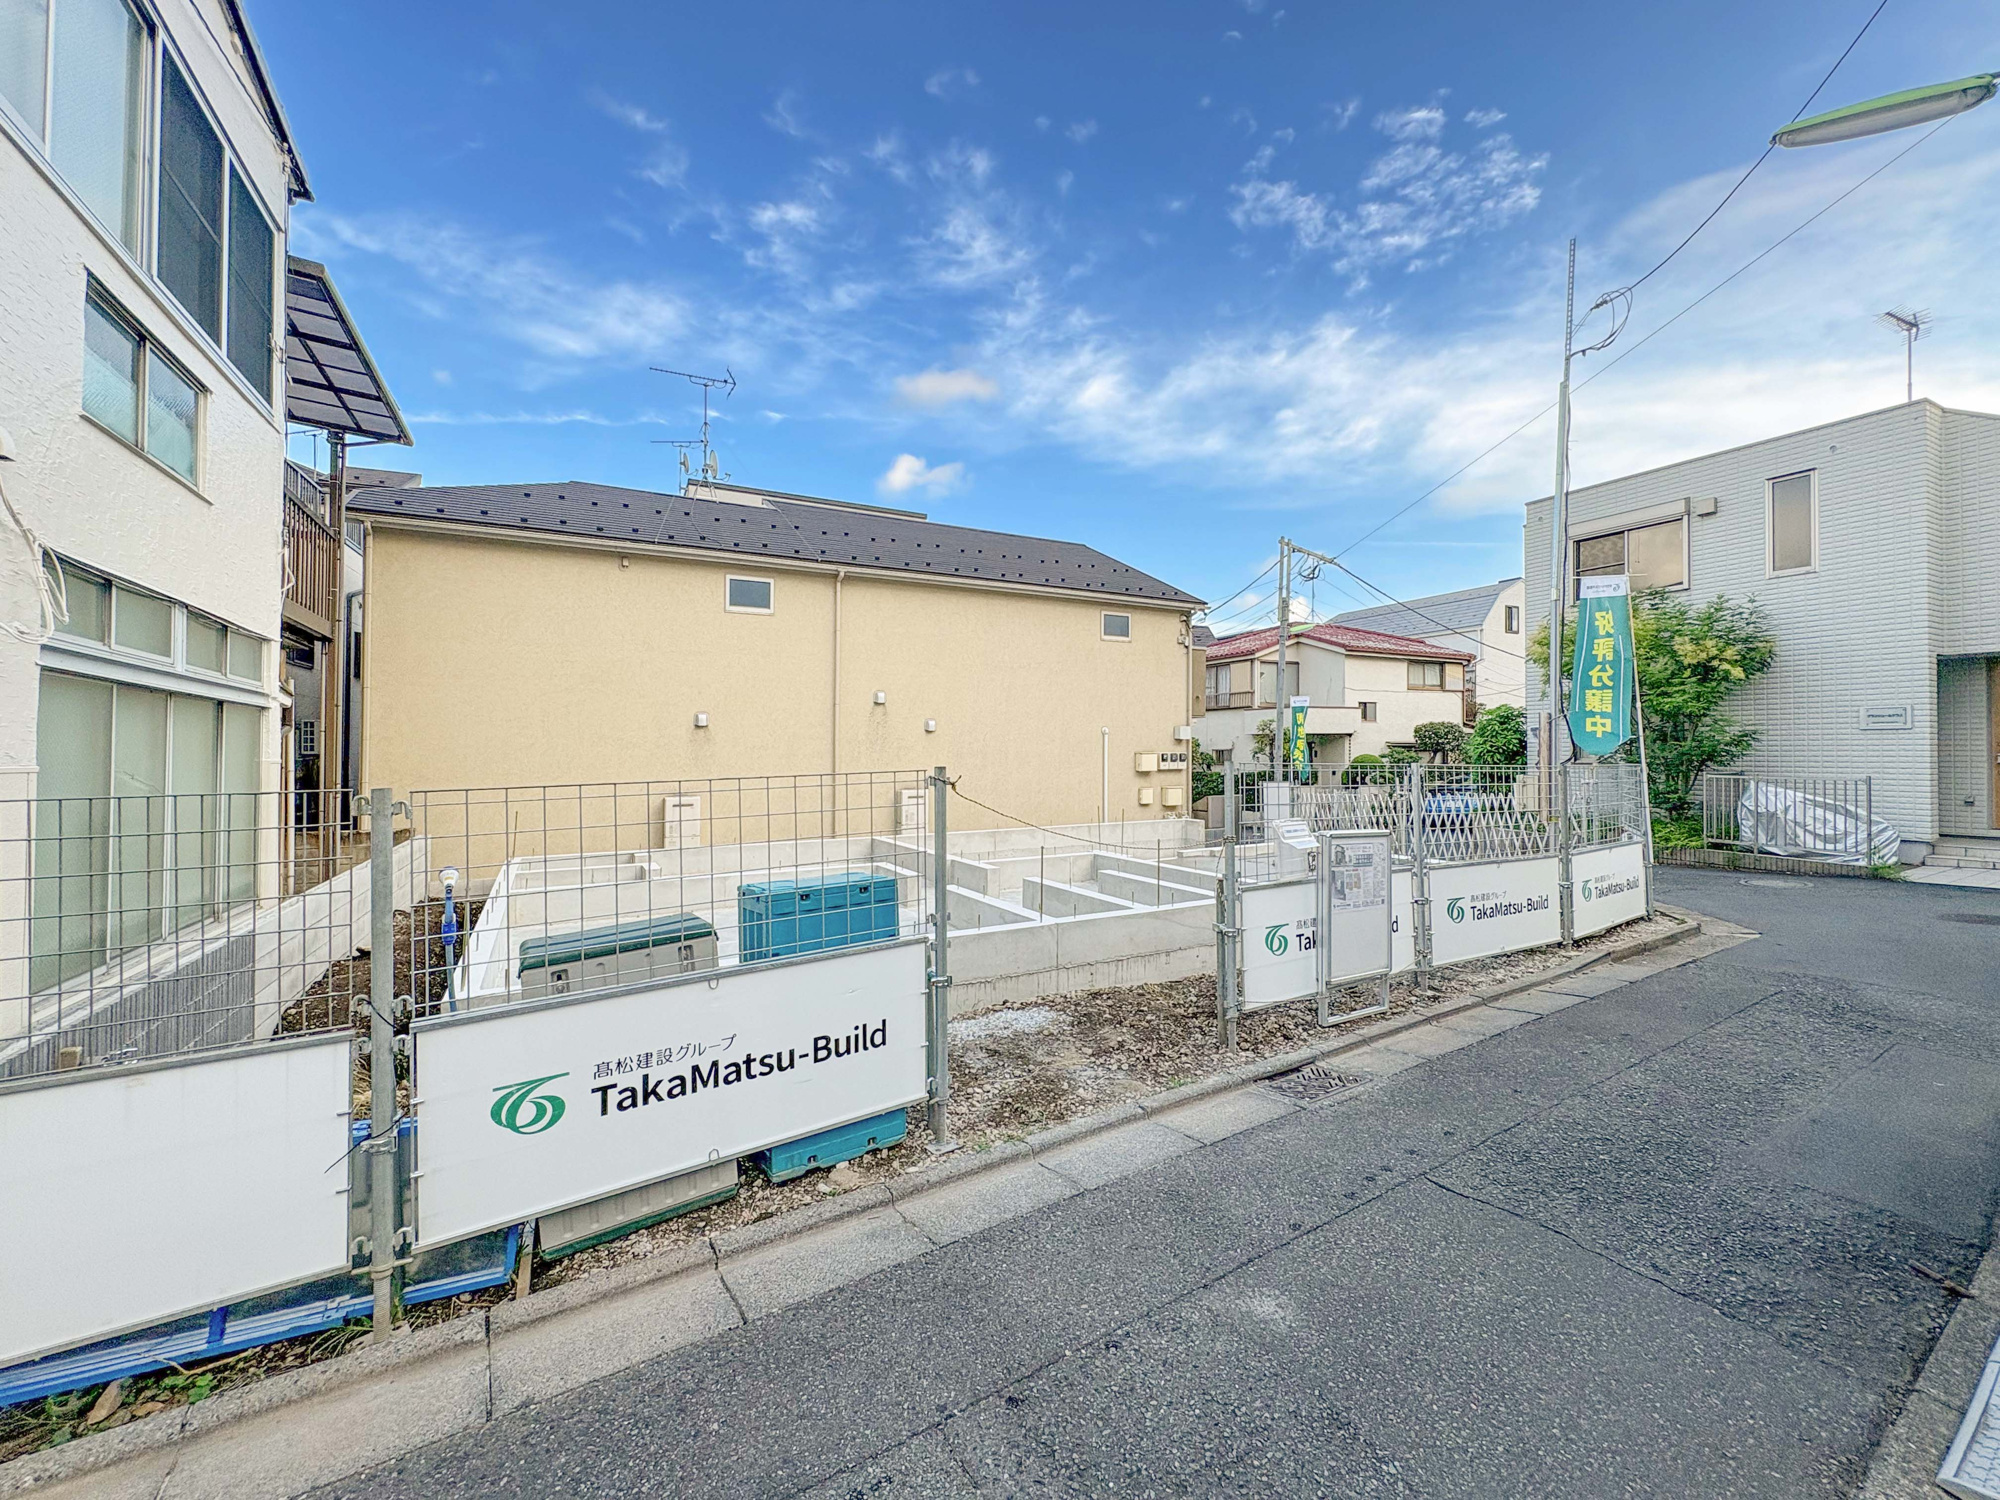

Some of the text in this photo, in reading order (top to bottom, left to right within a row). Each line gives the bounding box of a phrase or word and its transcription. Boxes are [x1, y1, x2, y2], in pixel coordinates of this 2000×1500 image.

[1595, 874, 1640, 899] TakaMatsu-Build
[1470, 894, 1549, 921] TakaMatsu-Build
[591, 1019, 888, 1117] TakaMatsu-Build
